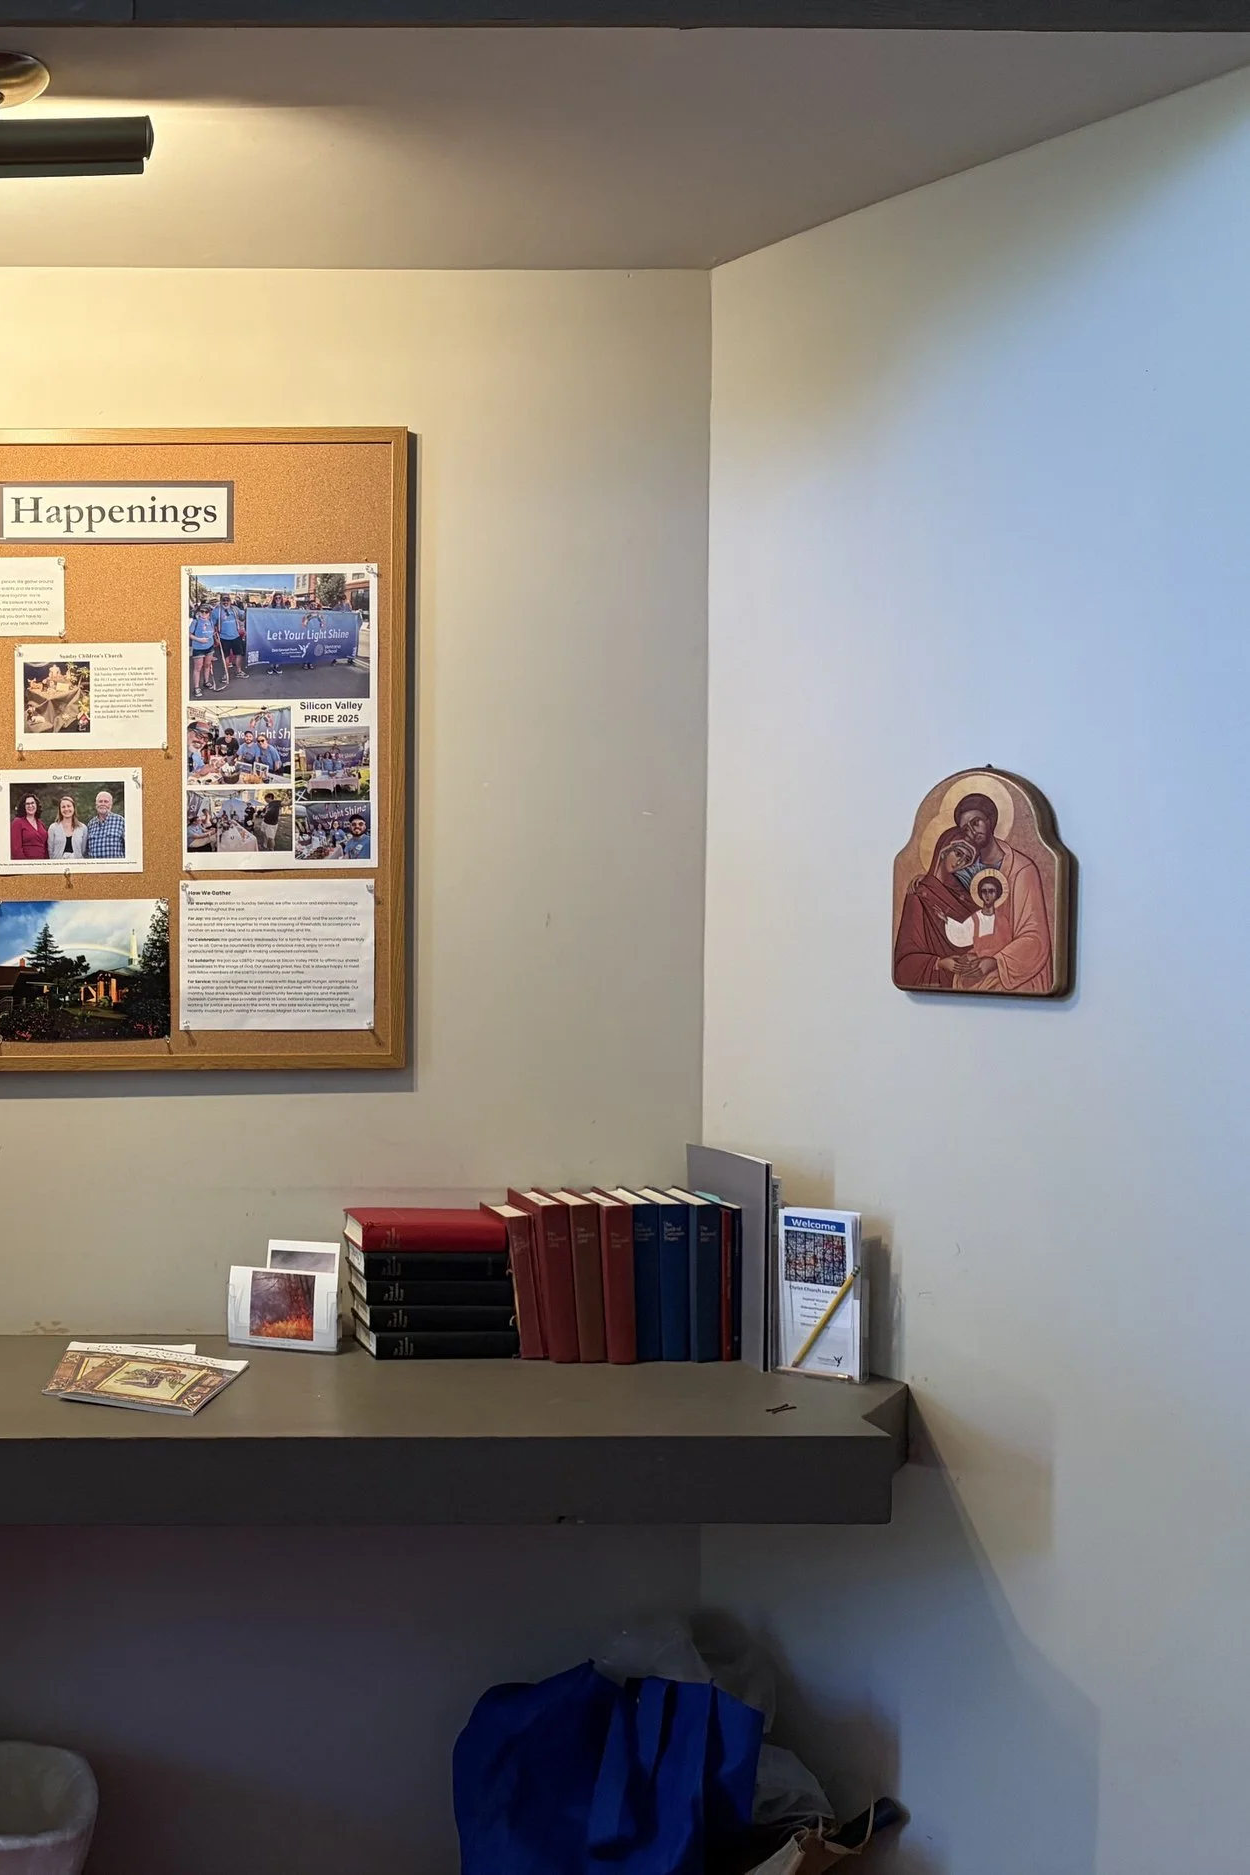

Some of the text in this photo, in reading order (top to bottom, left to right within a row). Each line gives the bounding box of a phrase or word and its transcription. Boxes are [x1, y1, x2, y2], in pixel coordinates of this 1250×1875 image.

[10, 496, 217, 532] Happenings
[267, 629, 349, 642] Let Your Light Shine
[300, 701, 363, 711] Silicon Valley
[304, 714, 359, 723] PRIDE 2025
[791, 1218, 836, 1232] Welcome
